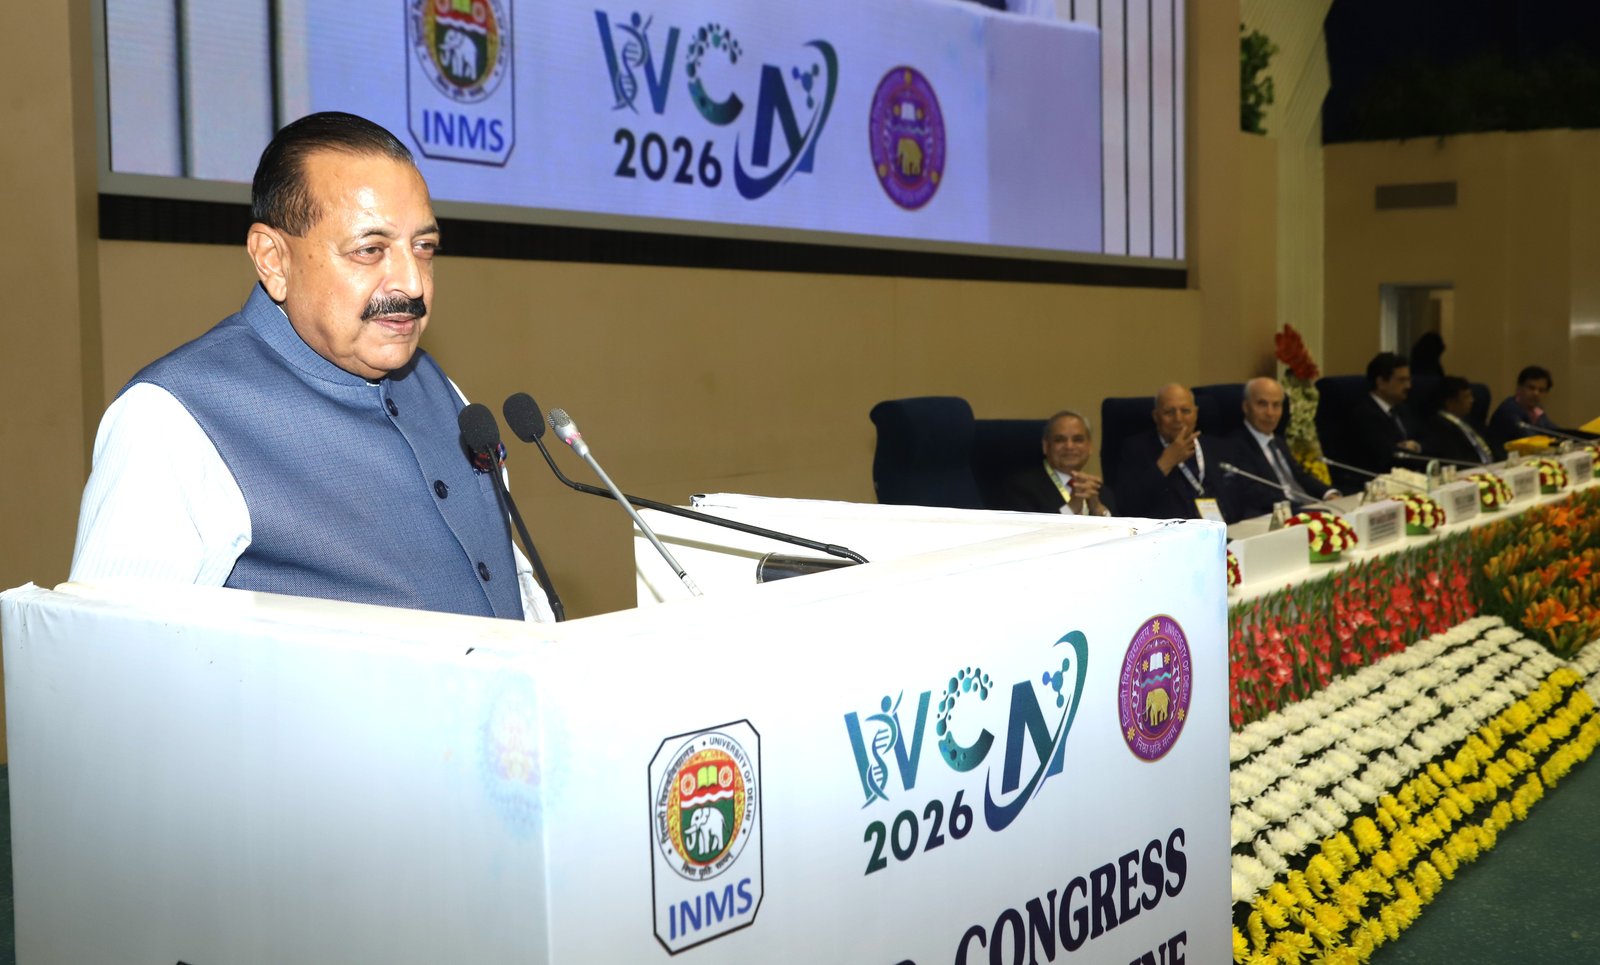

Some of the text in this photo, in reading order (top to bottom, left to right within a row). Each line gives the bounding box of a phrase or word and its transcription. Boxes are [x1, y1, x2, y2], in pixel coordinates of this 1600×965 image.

[423, 109, 504, 153] INMS
[613, 128, 722, 188] 2026
[709, 736, 754, 821] UNIVERSITY OF DELHI
[864, 789, 974, 876] 2026
[669, 878, 753, 941] INMS
[954, 827, 1188, 965] CONGRESS
